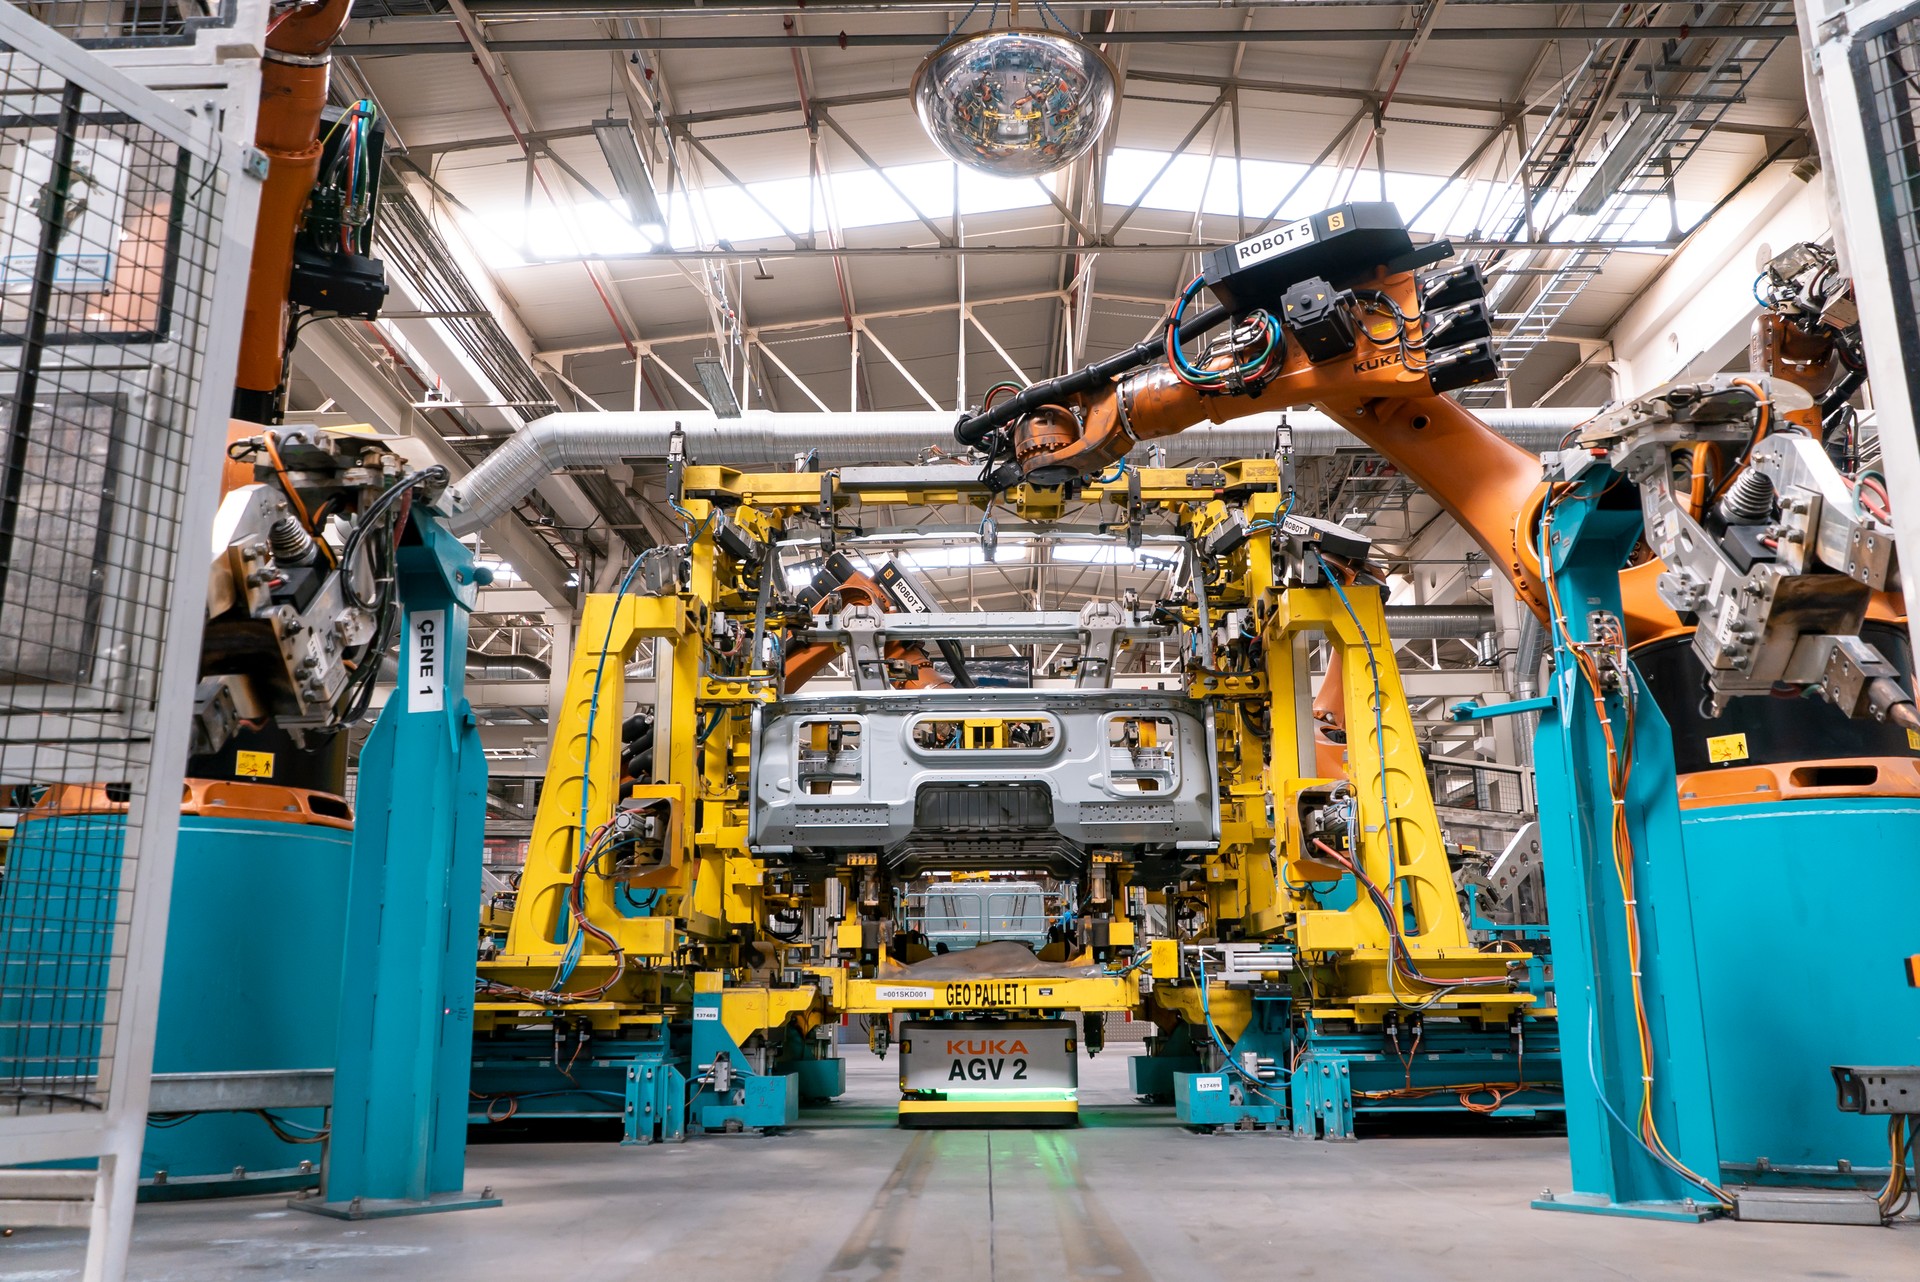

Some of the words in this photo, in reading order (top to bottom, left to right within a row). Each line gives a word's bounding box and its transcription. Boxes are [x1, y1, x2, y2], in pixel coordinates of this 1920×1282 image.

[1331, 215, 1341, 227] S
[1239, 229, 1295, 259] ROBOT
[1300, 223, 1310, 236] 5
[1353, 353, 1406, 374] KUKA
[1284, 520, 1303, 534] ROBOT
[895, 581, 919, 607] ROBOT
[417, 619, 435, 678] ÇENE
[419, 685, 433, 695] 1
[946, 983, 971, 1006] GEO
[975, 983, 1019, 1006] PALLET
[1022, 984, 1028, 1005] 1
[947, 1040, 1029, 1055] KUKA
[948, 1058, 1004, 1081] AGV
[1013, 1058, 1028, 1080] 2
